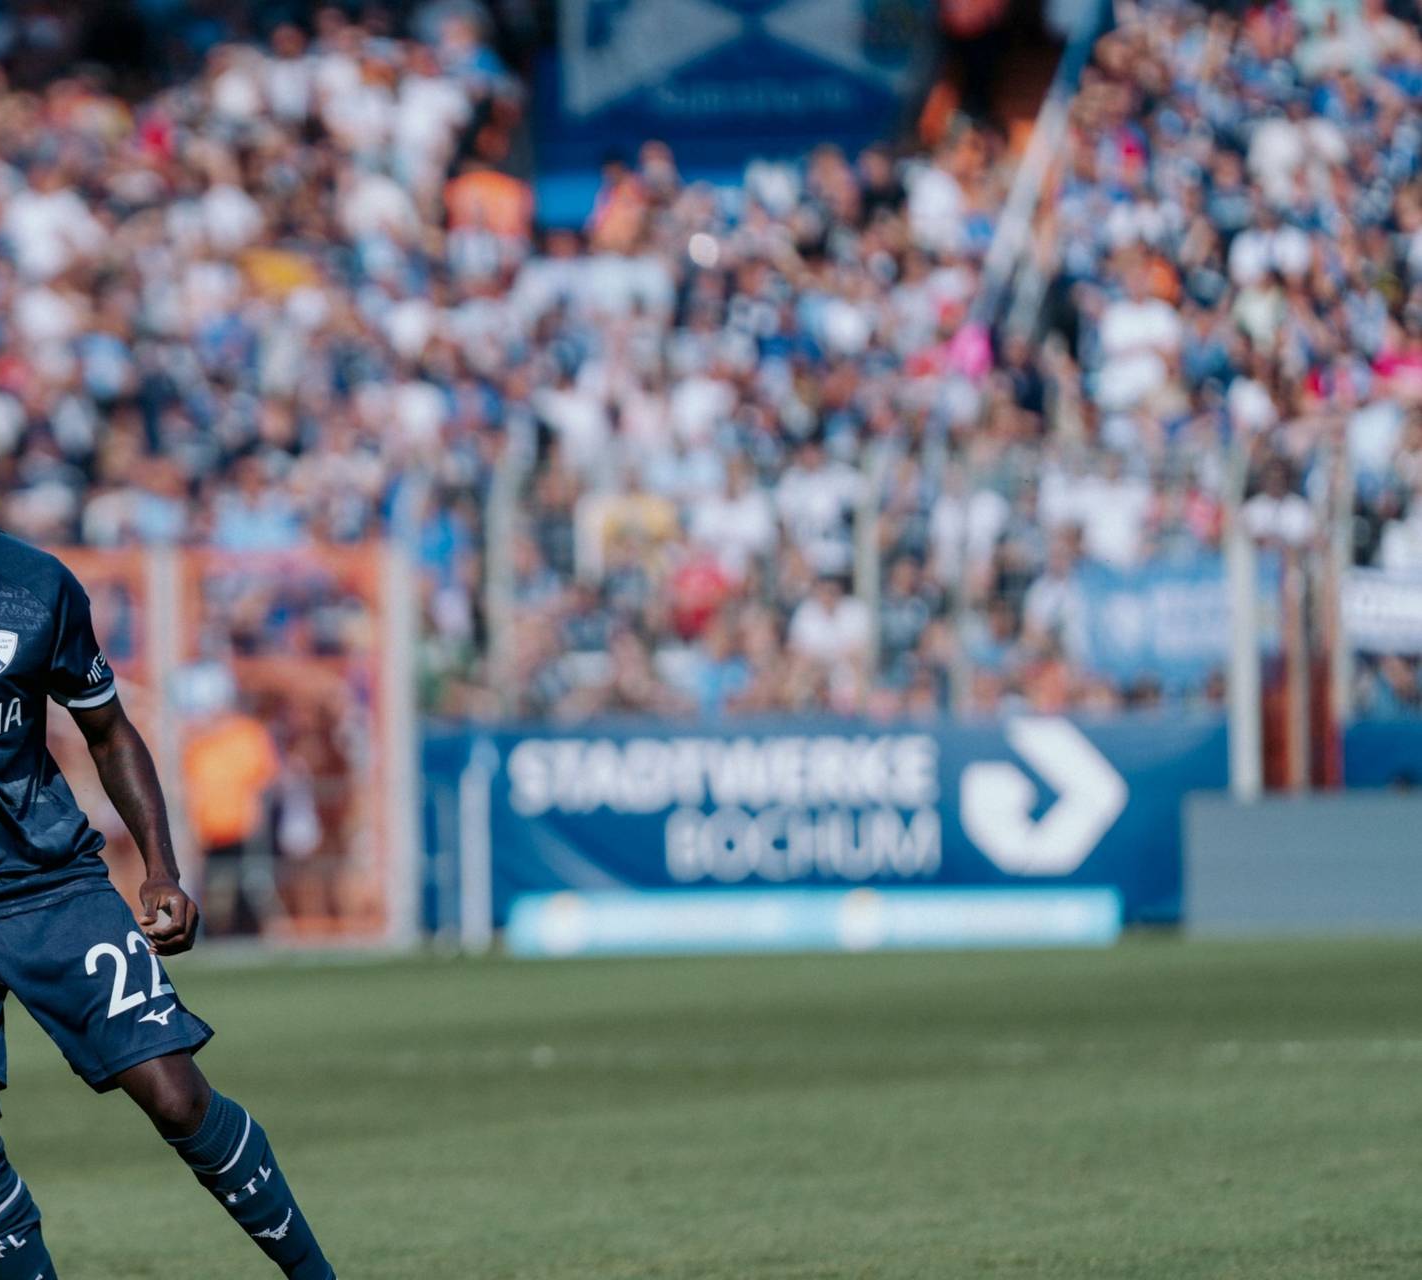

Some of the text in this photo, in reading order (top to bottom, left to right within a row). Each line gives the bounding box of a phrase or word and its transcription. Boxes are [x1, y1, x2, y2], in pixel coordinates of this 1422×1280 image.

[508, 735, 939, 815] STADTWERKE
[666, 806, 942, 882] BOCHUM
[84, 930, 175, 1019] 22
